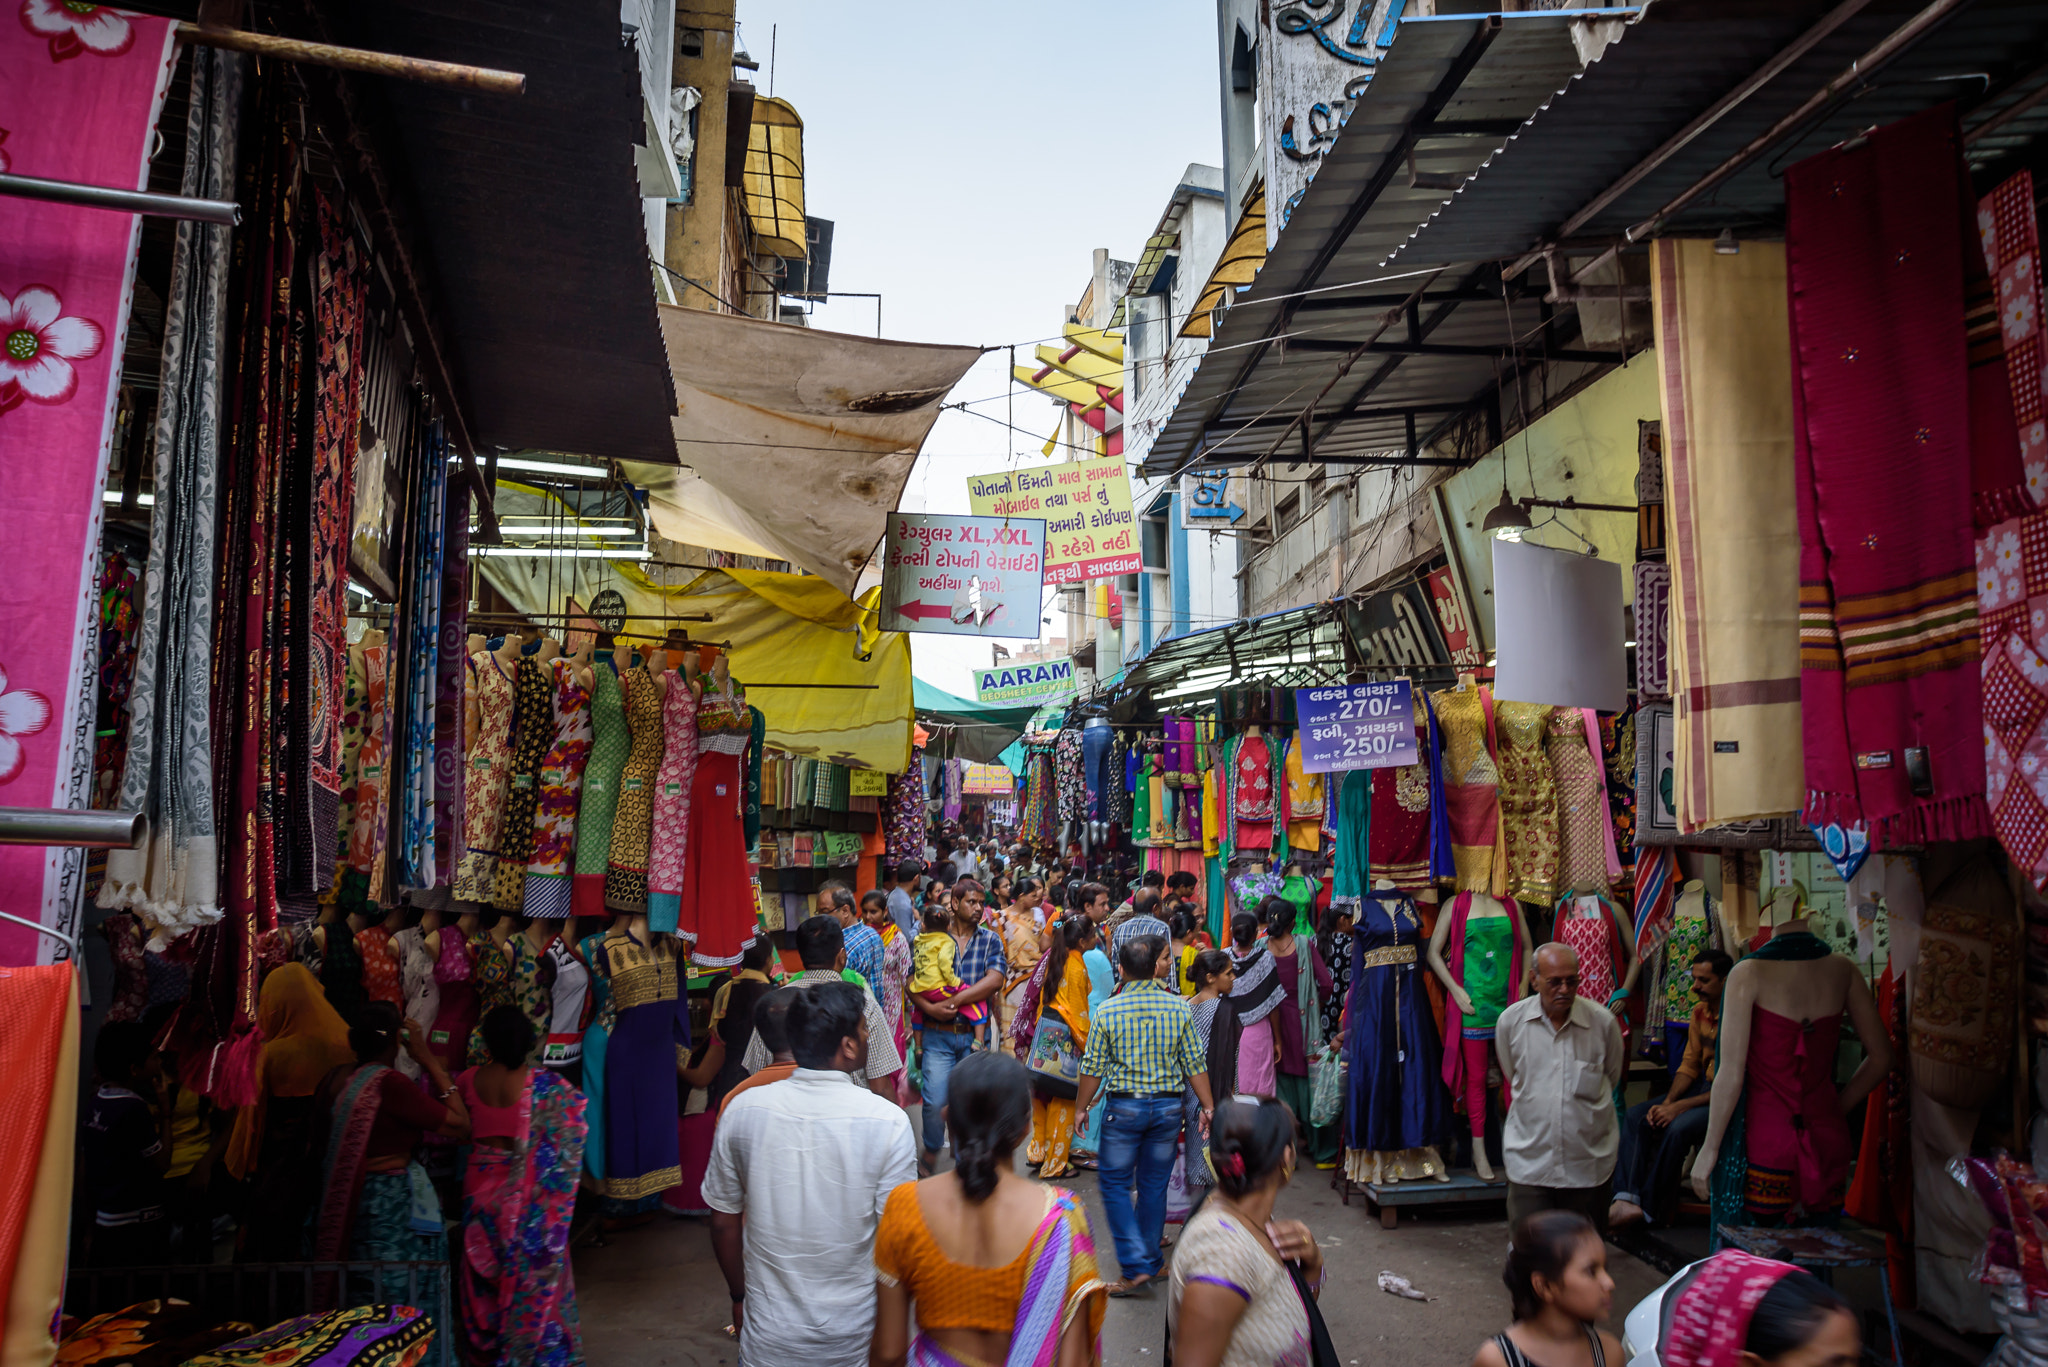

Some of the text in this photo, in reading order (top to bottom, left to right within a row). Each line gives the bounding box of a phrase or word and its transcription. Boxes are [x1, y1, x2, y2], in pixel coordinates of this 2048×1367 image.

[972, 464, 1123, 498] પોતાનો કિંમતી માલ સામાન
[993, 483, 1109, 515] મોબાઈલ તથા પર્સ નું
[1048, 507, 1132, 533] અમારી કોઈપણ
[899, 521, 1033, 547] રેગ્યુલર XL,XXL
[1045, 529, 1131, 560] રી રહેશે નહીં
[936, 548, 980, 569] ટોપની
[986, 551, 1038, 573] વેરાઈટી
[1088, 557, 1140, 577] સાવધાન
[919, 574, 962, 591] અહીંયા
[981, 661, 1071, 690] AARAM
[981, 680, 1074, 702] BEDSHEET CENTRE
[1353, 684, 1399, 697] લાયરા
[1339, 696, 1402, 720] 270/-
[1342, 734, 1405, 757] 250/-
[836, 836, 861, 854] 250
